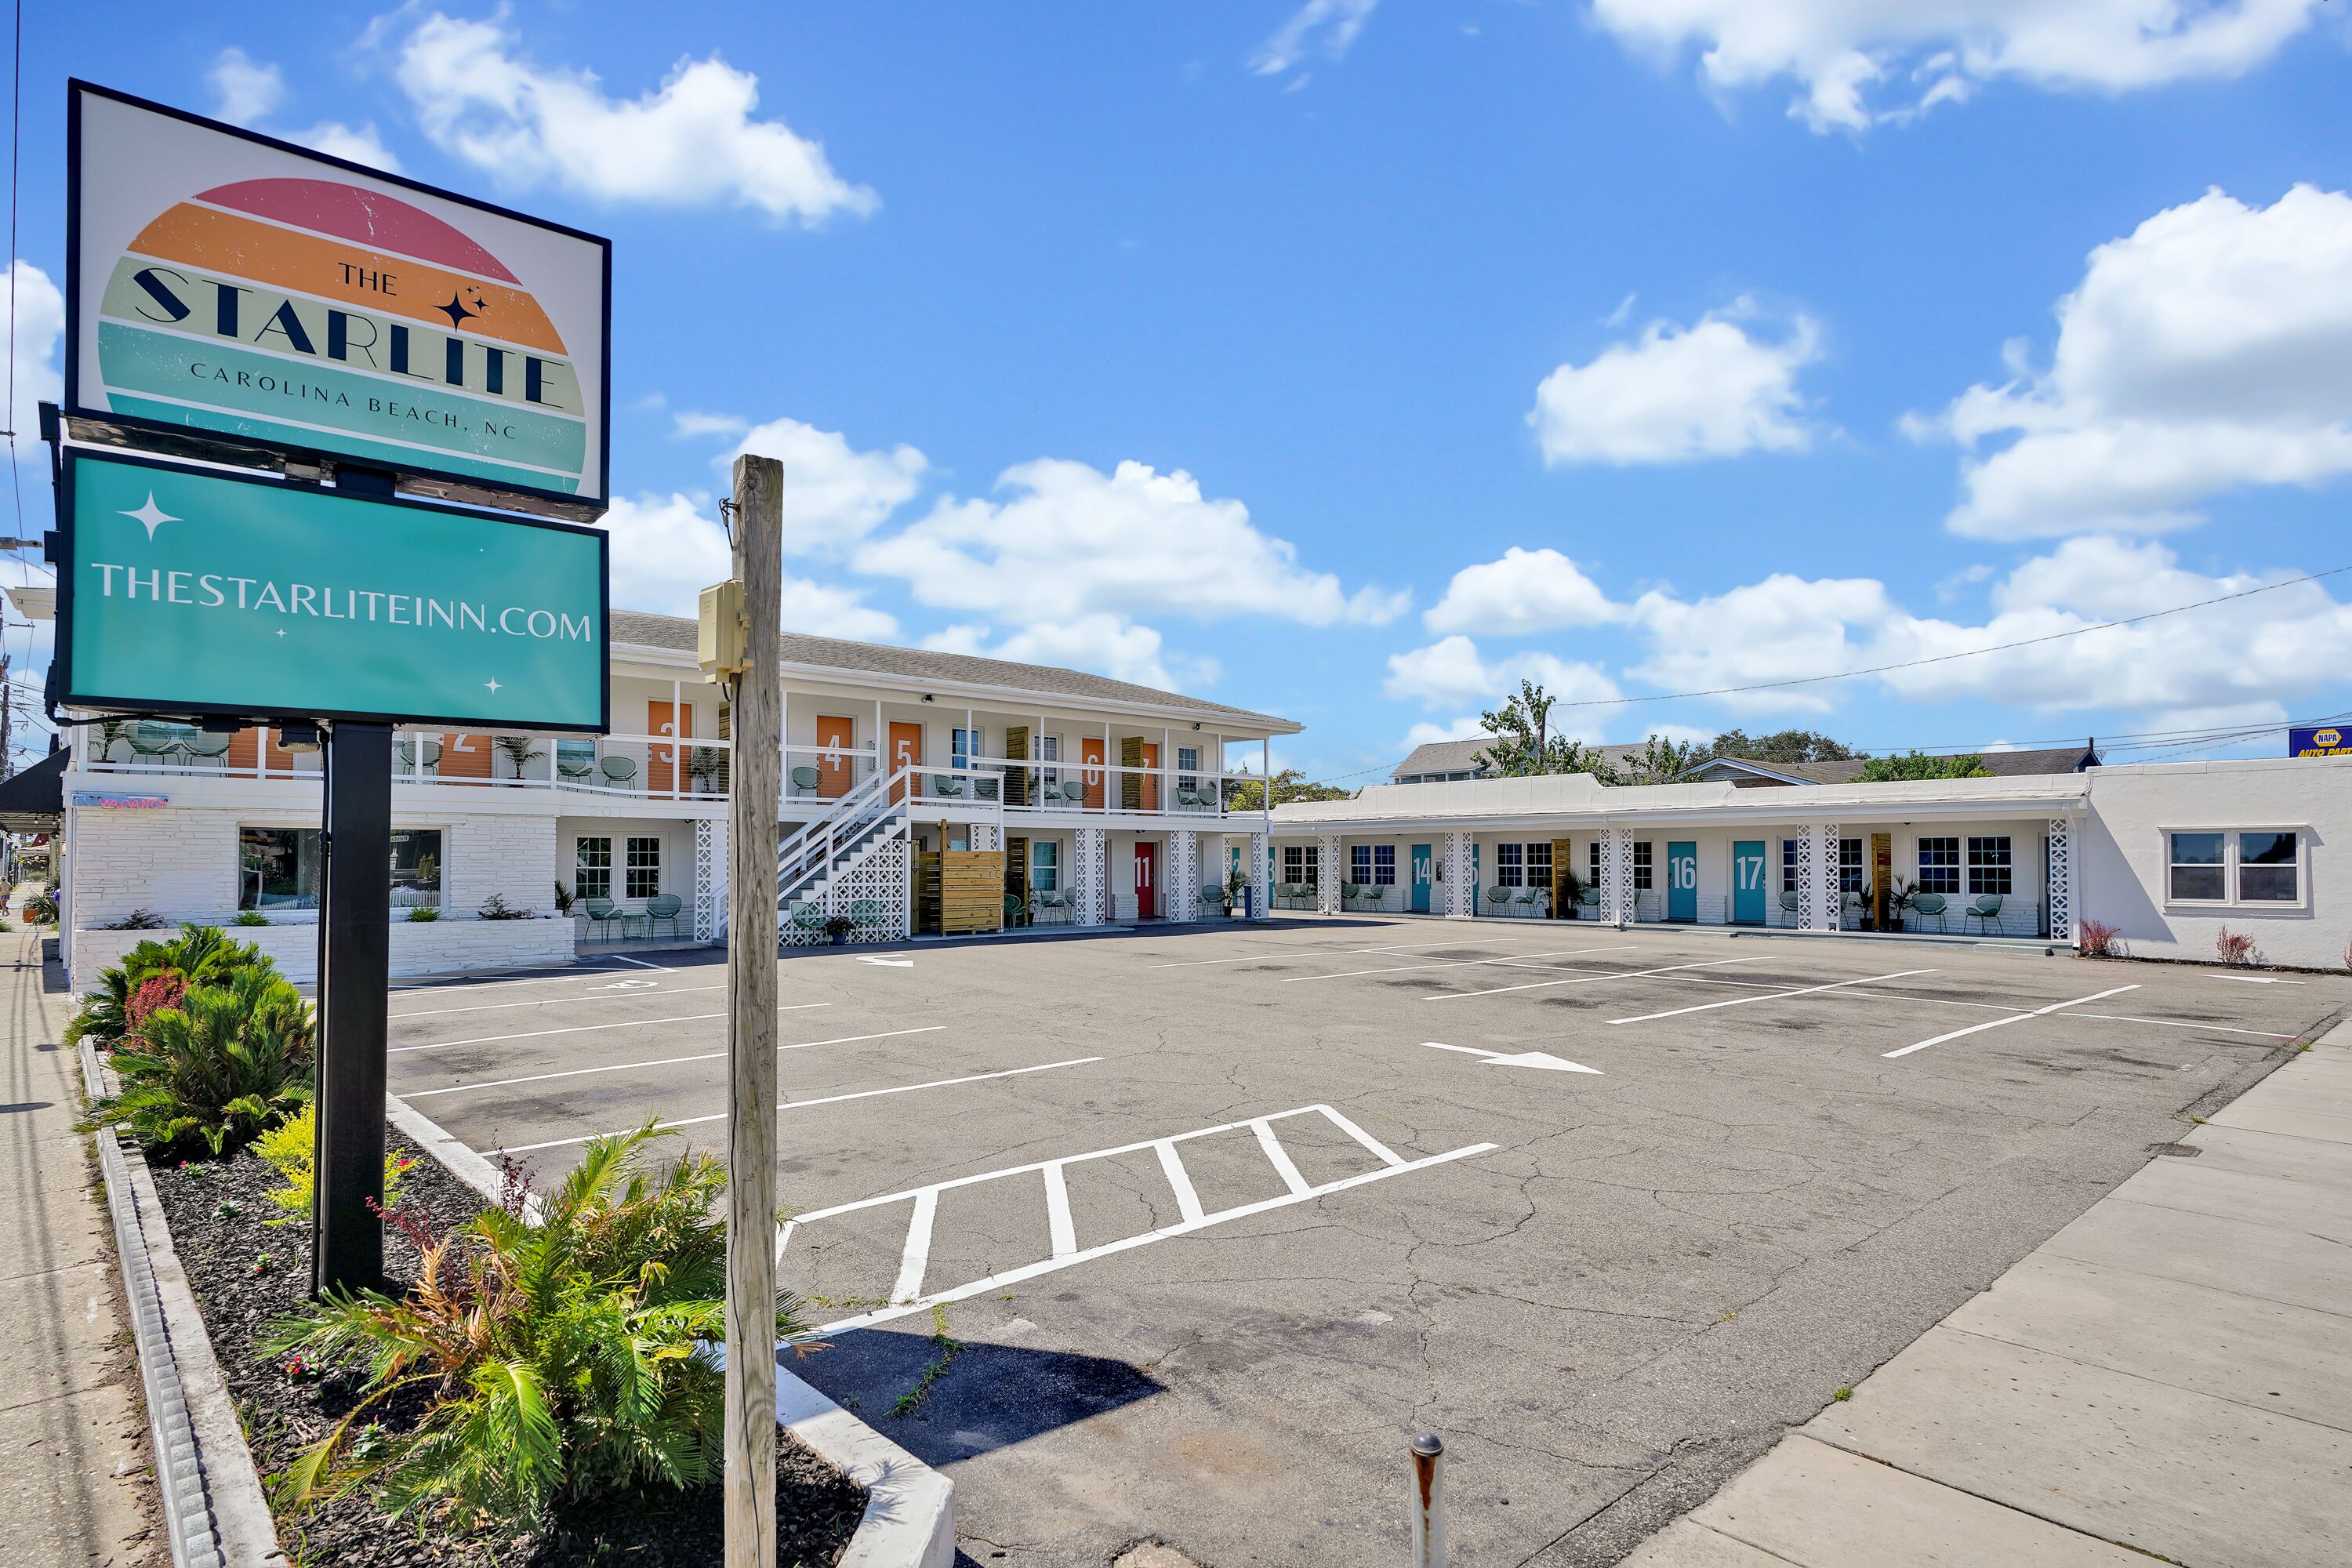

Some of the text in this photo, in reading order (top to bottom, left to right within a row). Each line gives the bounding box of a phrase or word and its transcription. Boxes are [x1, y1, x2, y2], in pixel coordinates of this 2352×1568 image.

[338, 262, 397, 296] THE
[132, 267, 564, 409] STARLITE
[191, 363, 515, 439] CAROLINA BEACH, NC
[91, 562, 591, 642] THESTARLITEINN.COM
[660, 722, 675, 763] 3
[825, 735, 841, 771] 4
[2298, 749, 2325, 757] AUTO
[2318, 734, 2337, 742] NAPA
[897, 740, 912, 773] 5
[1087, 754, 1098, 786] 6
[1135, 856, 1149, 887] 11
[1268, 858, 1275, 883] 3
[1414, 857, 1432, 884] 14
[1472, 858, 1479, 885] 5
[1671, 856, 1696, 889] 16
[1737, 856, 1764, 890] 17
